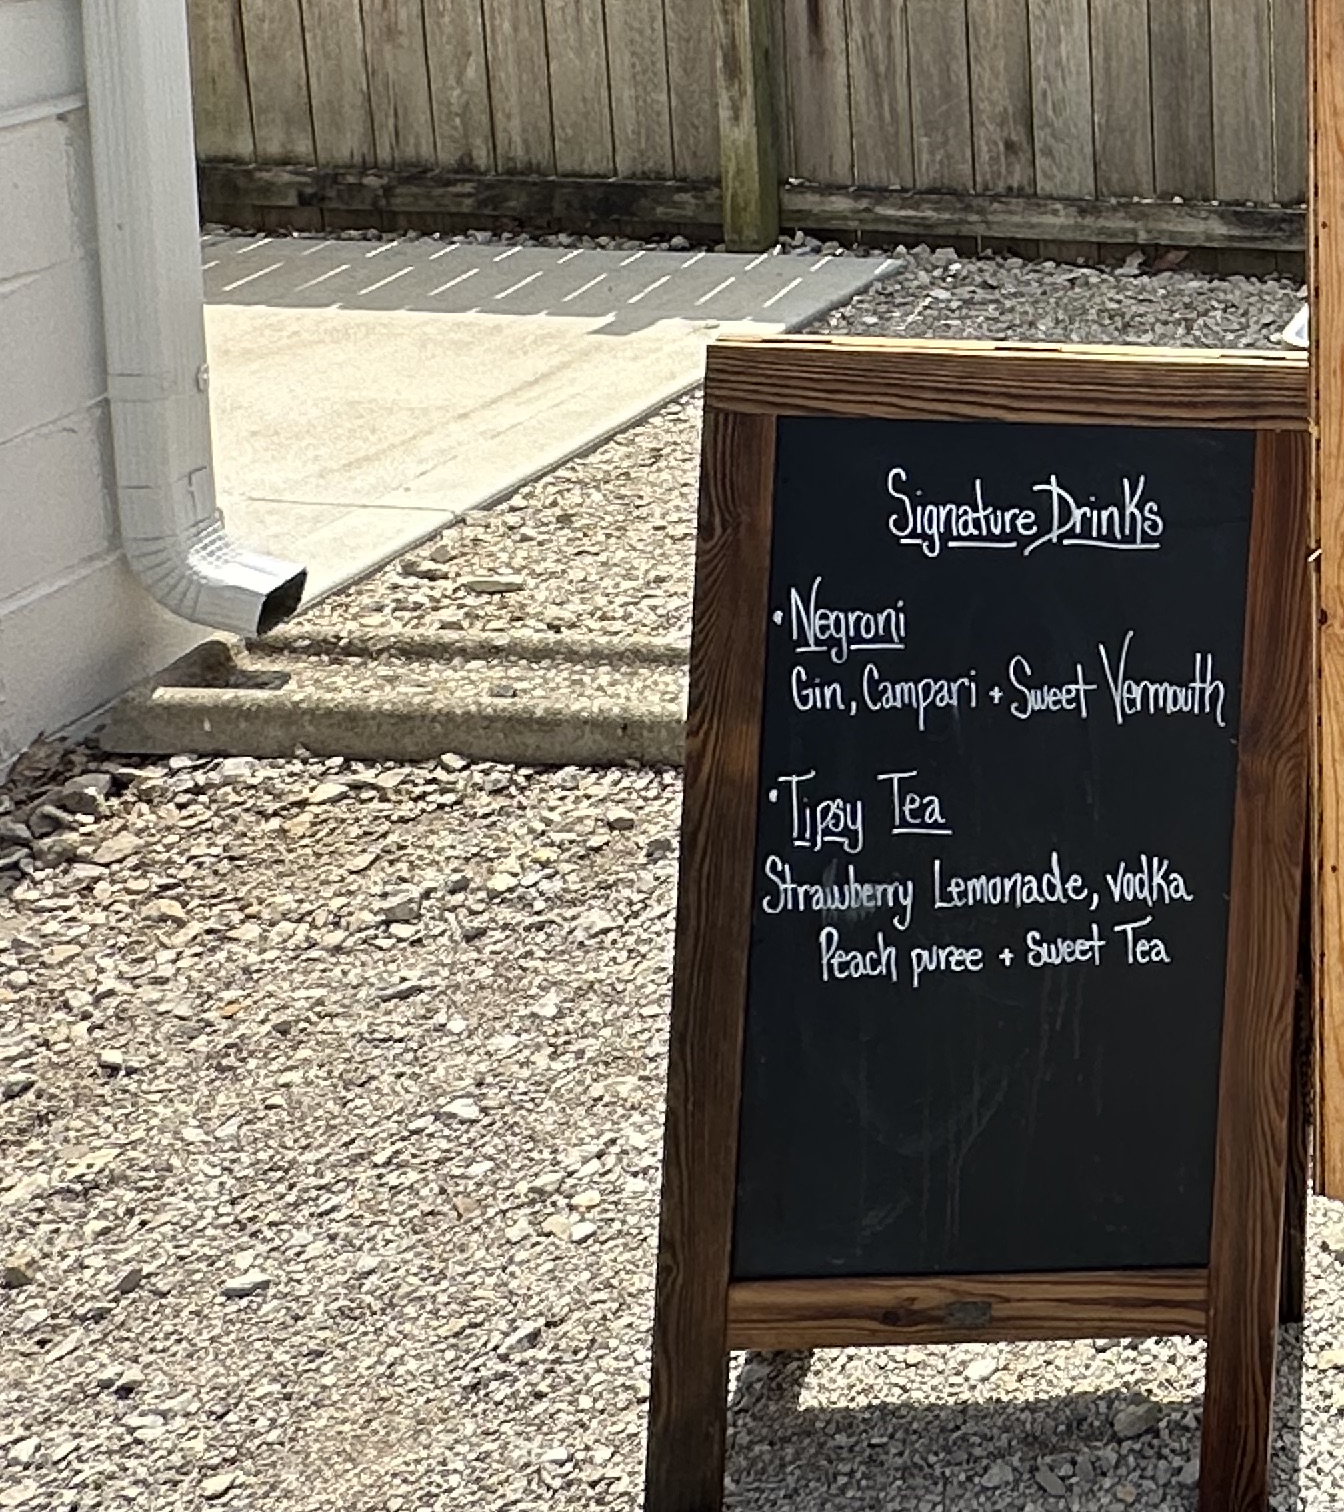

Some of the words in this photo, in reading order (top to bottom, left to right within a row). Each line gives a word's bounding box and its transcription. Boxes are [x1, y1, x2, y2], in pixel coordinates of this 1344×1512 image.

[887, 467, 1038, 558] Signature
[790, 576, 906, 664] Negroni
[791, 665, 857, 716] Gin,
[862, 663, 976, 731] Campari
[1008, 654, 1098, 720] Sweet
[1098, 630, 1226, 728] Vermouth
[777, 769, 864, 854] Tipsy
[876, 770, 947, 827] Tea
[762, 854, 914, 931] Strawberry
[934, 850, 1099, 911] Lemonade,
[818, 926, 898, 982] Peach
[910, 944, 984, 988] puree
[1026, 922, 1106, 968] Sweet
[1113, 915, 1172, 965] Tea
